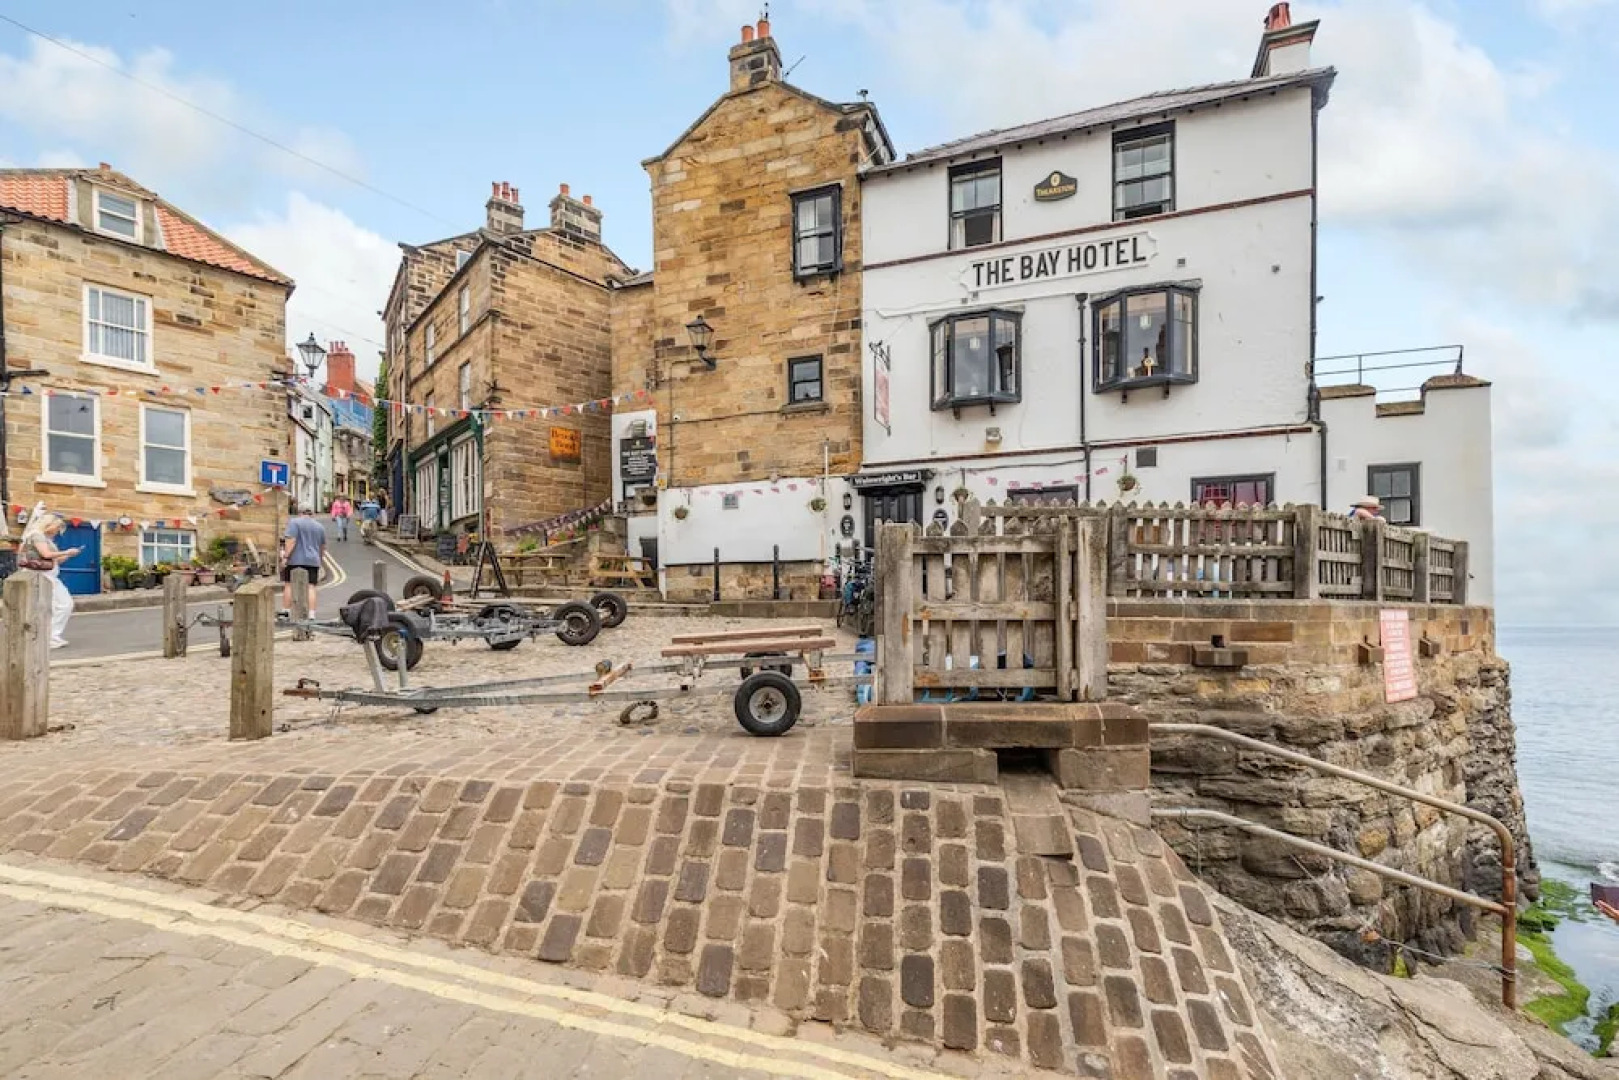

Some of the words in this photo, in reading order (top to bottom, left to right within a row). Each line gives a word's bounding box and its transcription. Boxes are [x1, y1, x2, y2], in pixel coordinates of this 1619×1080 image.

[972, 258, 1014, 287] THE
[1020, 250, 1060, 280] BAY
[1068, 237, 1146, 273] HOTEL
